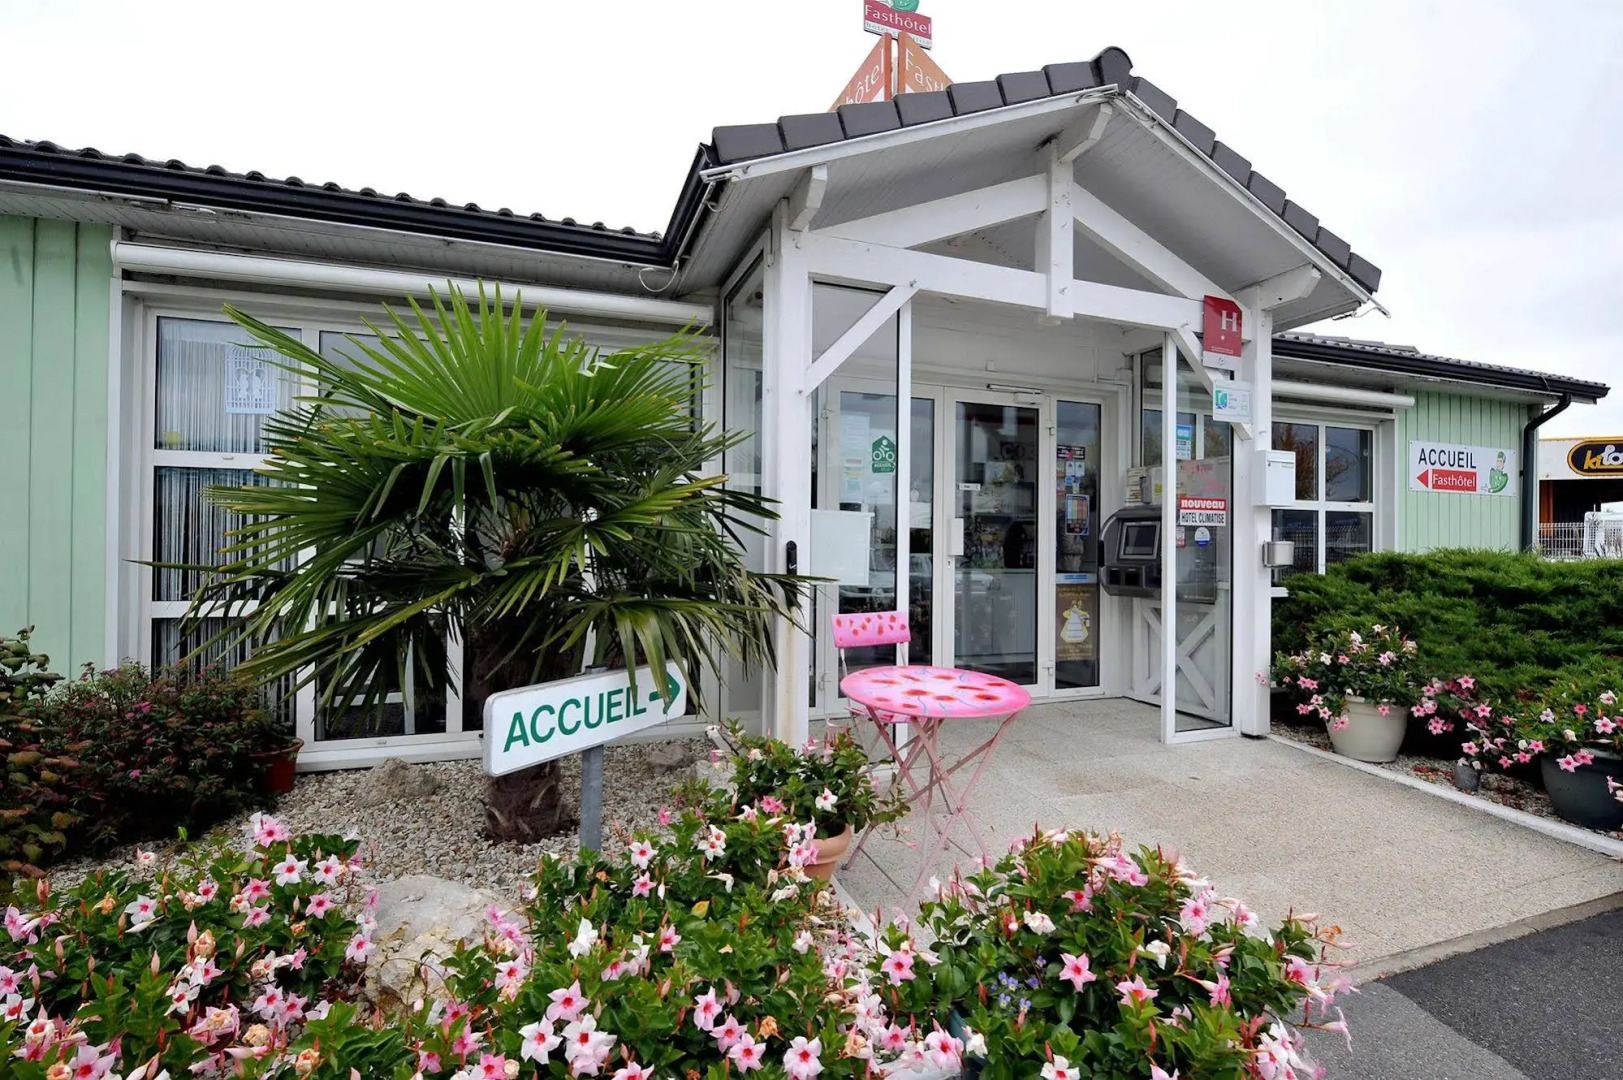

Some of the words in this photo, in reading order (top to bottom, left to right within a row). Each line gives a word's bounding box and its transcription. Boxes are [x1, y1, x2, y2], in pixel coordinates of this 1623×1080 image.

[865, 4, 931, 35] Fasthôtel
[846, 48, 884, 104] ôtel
[1221, 311, 1238, 333] H
[1418, 448, 1477, 469] ACCUEIL
[1584, 444, 1623, 470] kilo
[1433, 474, 1475, 488] Fasthôtel
[1182, 512, 1197, 523] HOTEL
[503, 685, 647, 753] ACCUEIL
